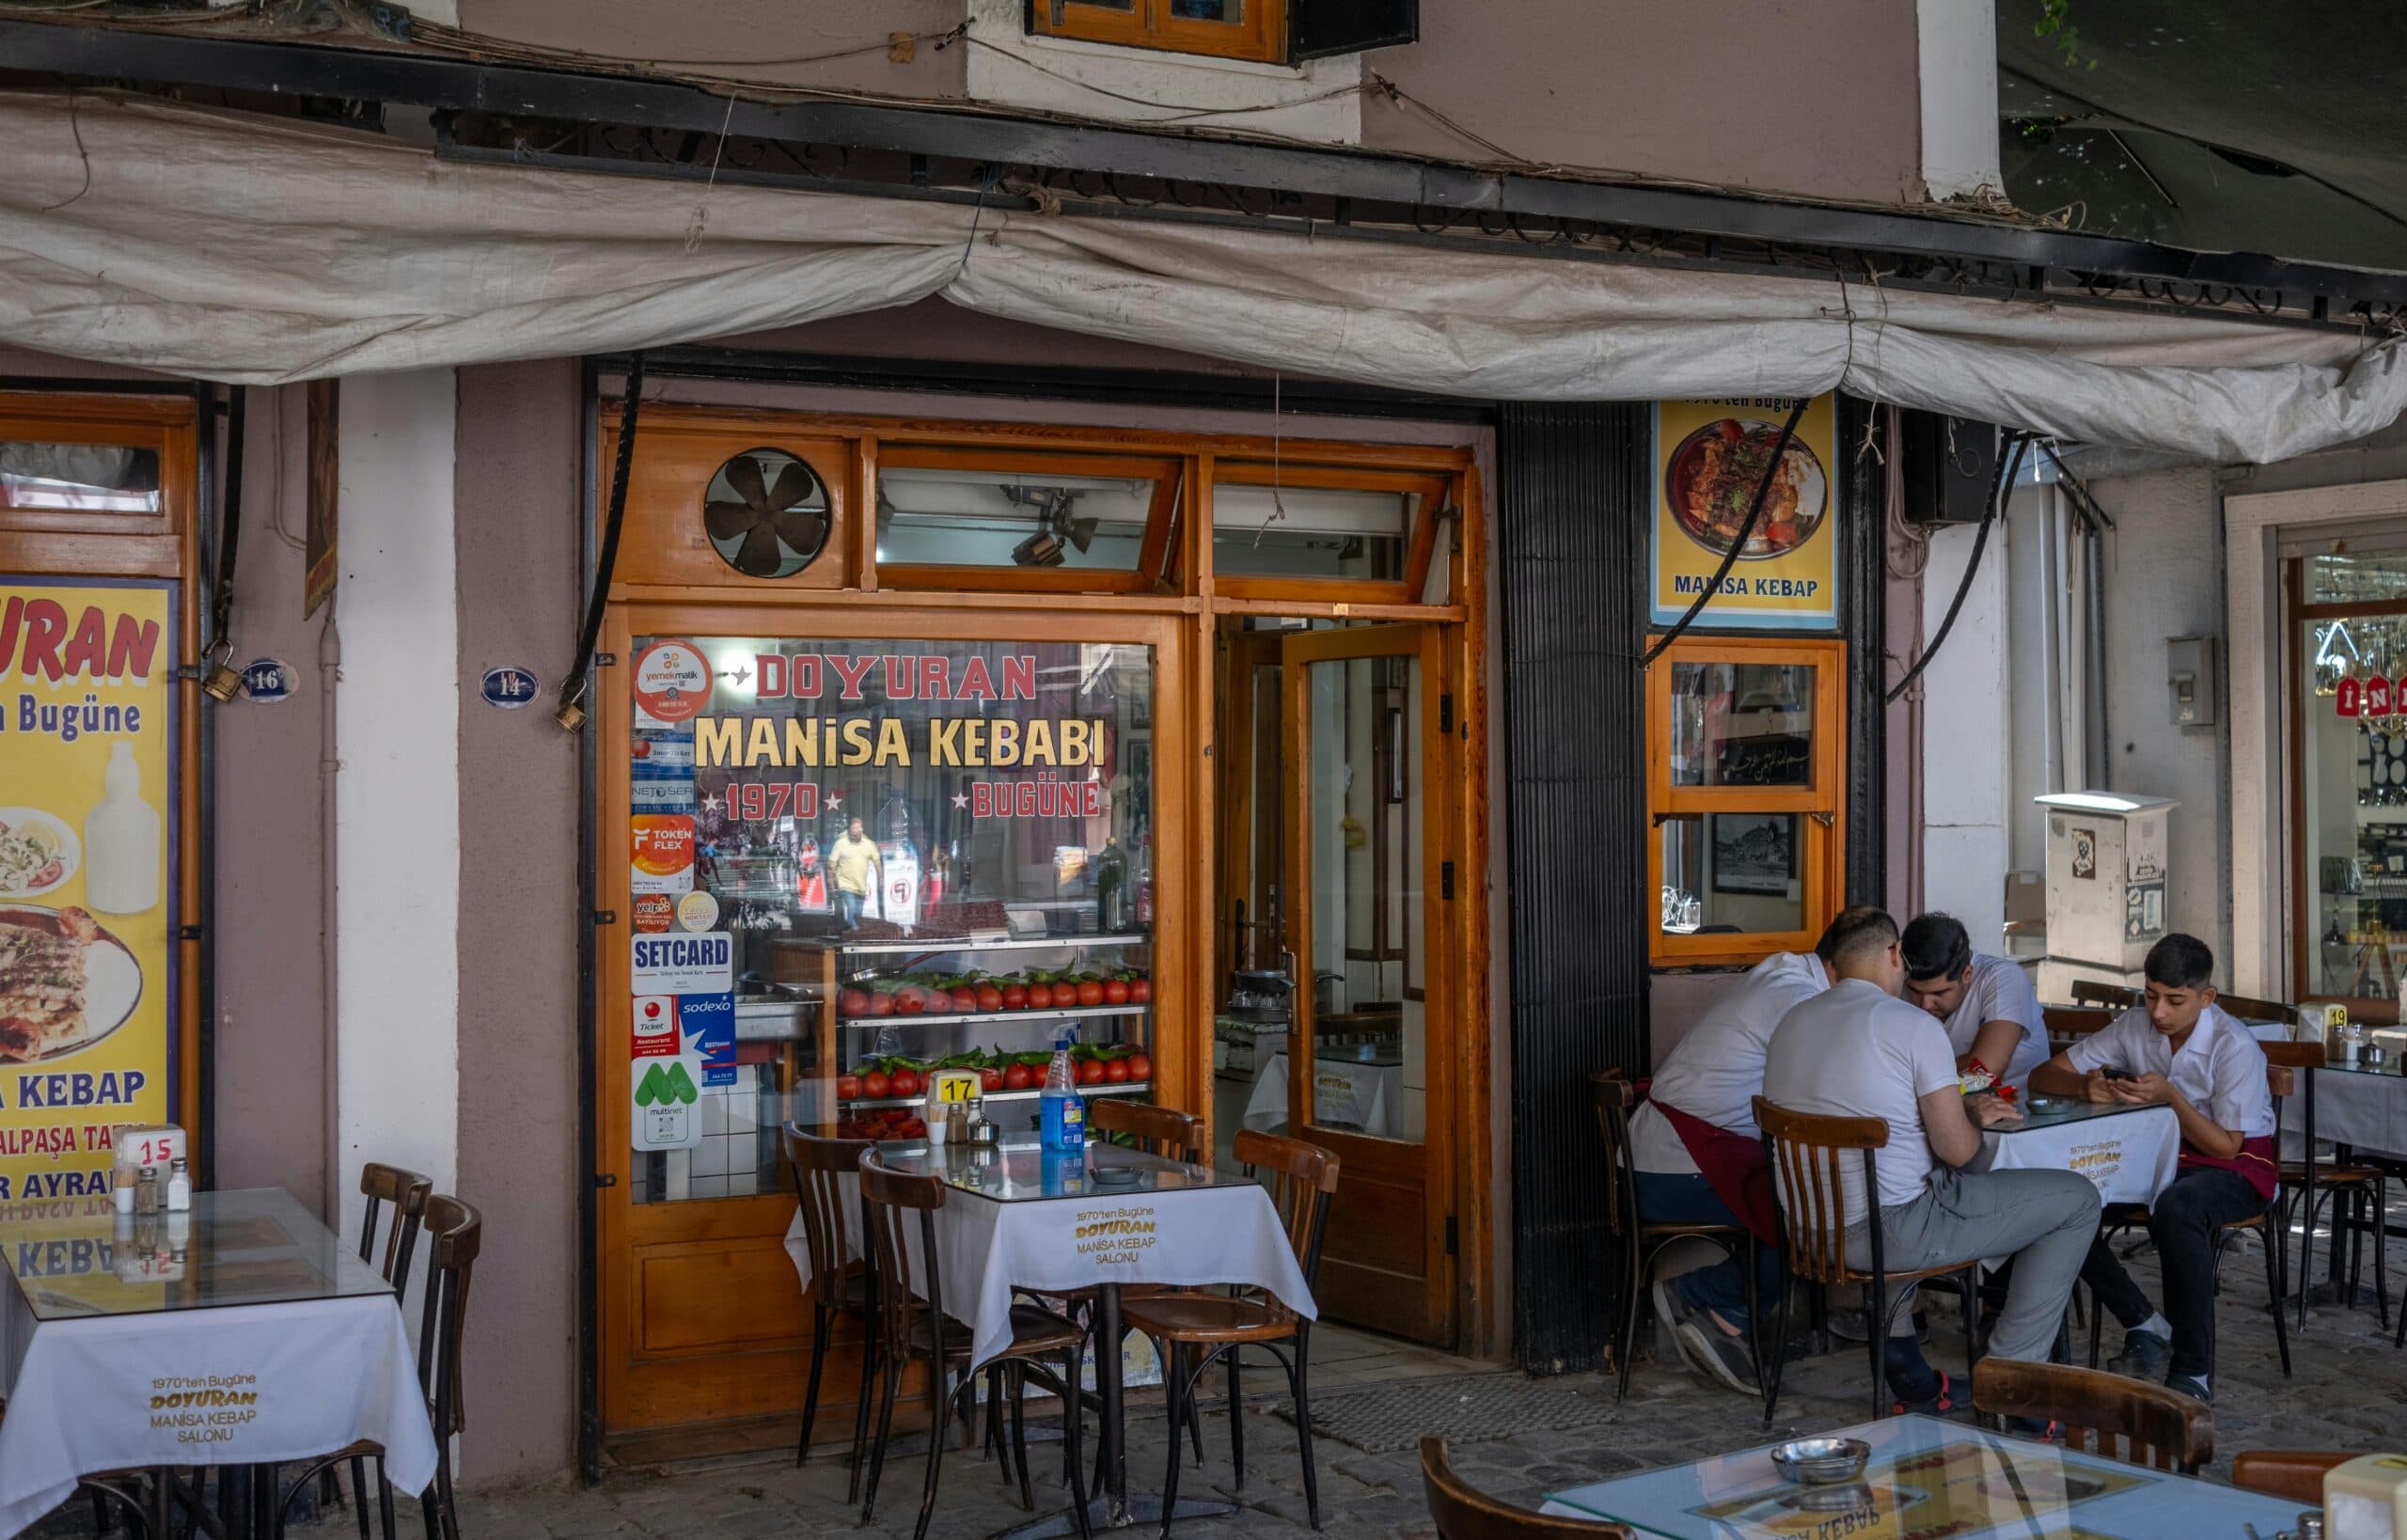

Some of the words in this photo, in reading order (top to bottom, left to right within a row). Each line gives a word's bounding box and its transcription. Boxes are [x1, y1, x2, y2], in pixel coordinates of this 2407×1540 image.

[1755, 578, 1818, 597] KEBAP
[255, 669, 278, 690] 16
[755, 653, 1036, 700] DOYURAN
[500, 677, 520, 696] 14
[19, 694, 141, 742] Bugüne
[929, 717, 1107, 768] KEBABI
[725, 781, 820, 821] 1970
[971, 771, 1100, 818] BUGÜNE
[653, 830, 692, 840] TOKEN
[653, 841, 682, 850] FLEX
[637, 903, 659, 913] yelp
[635, 938, 729, 968] SETCARD
[684, 999, 731, 1014] sodexo
[2332, 1009, 2346, 1025] 19
[637, 1037, 671, 1045] Restaurant
[19, 1071, 145, 1108] KEBAP
[945, 1079, 972, 1101] 17
[650, 1107, 683, 1115] multinet
[140, 1139, 172, 1165] 15
[22, 1171, 113, 1200] AYRA
[1118, 1206, 1155, 1218] Bugüne
[1076, 1218, 1156, 1238] DOYURAN
[1118, 1236, 1156, 1249] KEBAP
[1095, 1251, 1139, 1265] SALONU
[151, 1376, 206, 1389] 1970'ten
[208, 1374, 257, 1389] Bugüne
[150, 1389, 258, 1408] DOYURAN
[150, 1411, 205, 1428] MANİSA
[208, 1410, 257, 1425] KEBAP
[177, 1428, 234, 1443] SALONU
